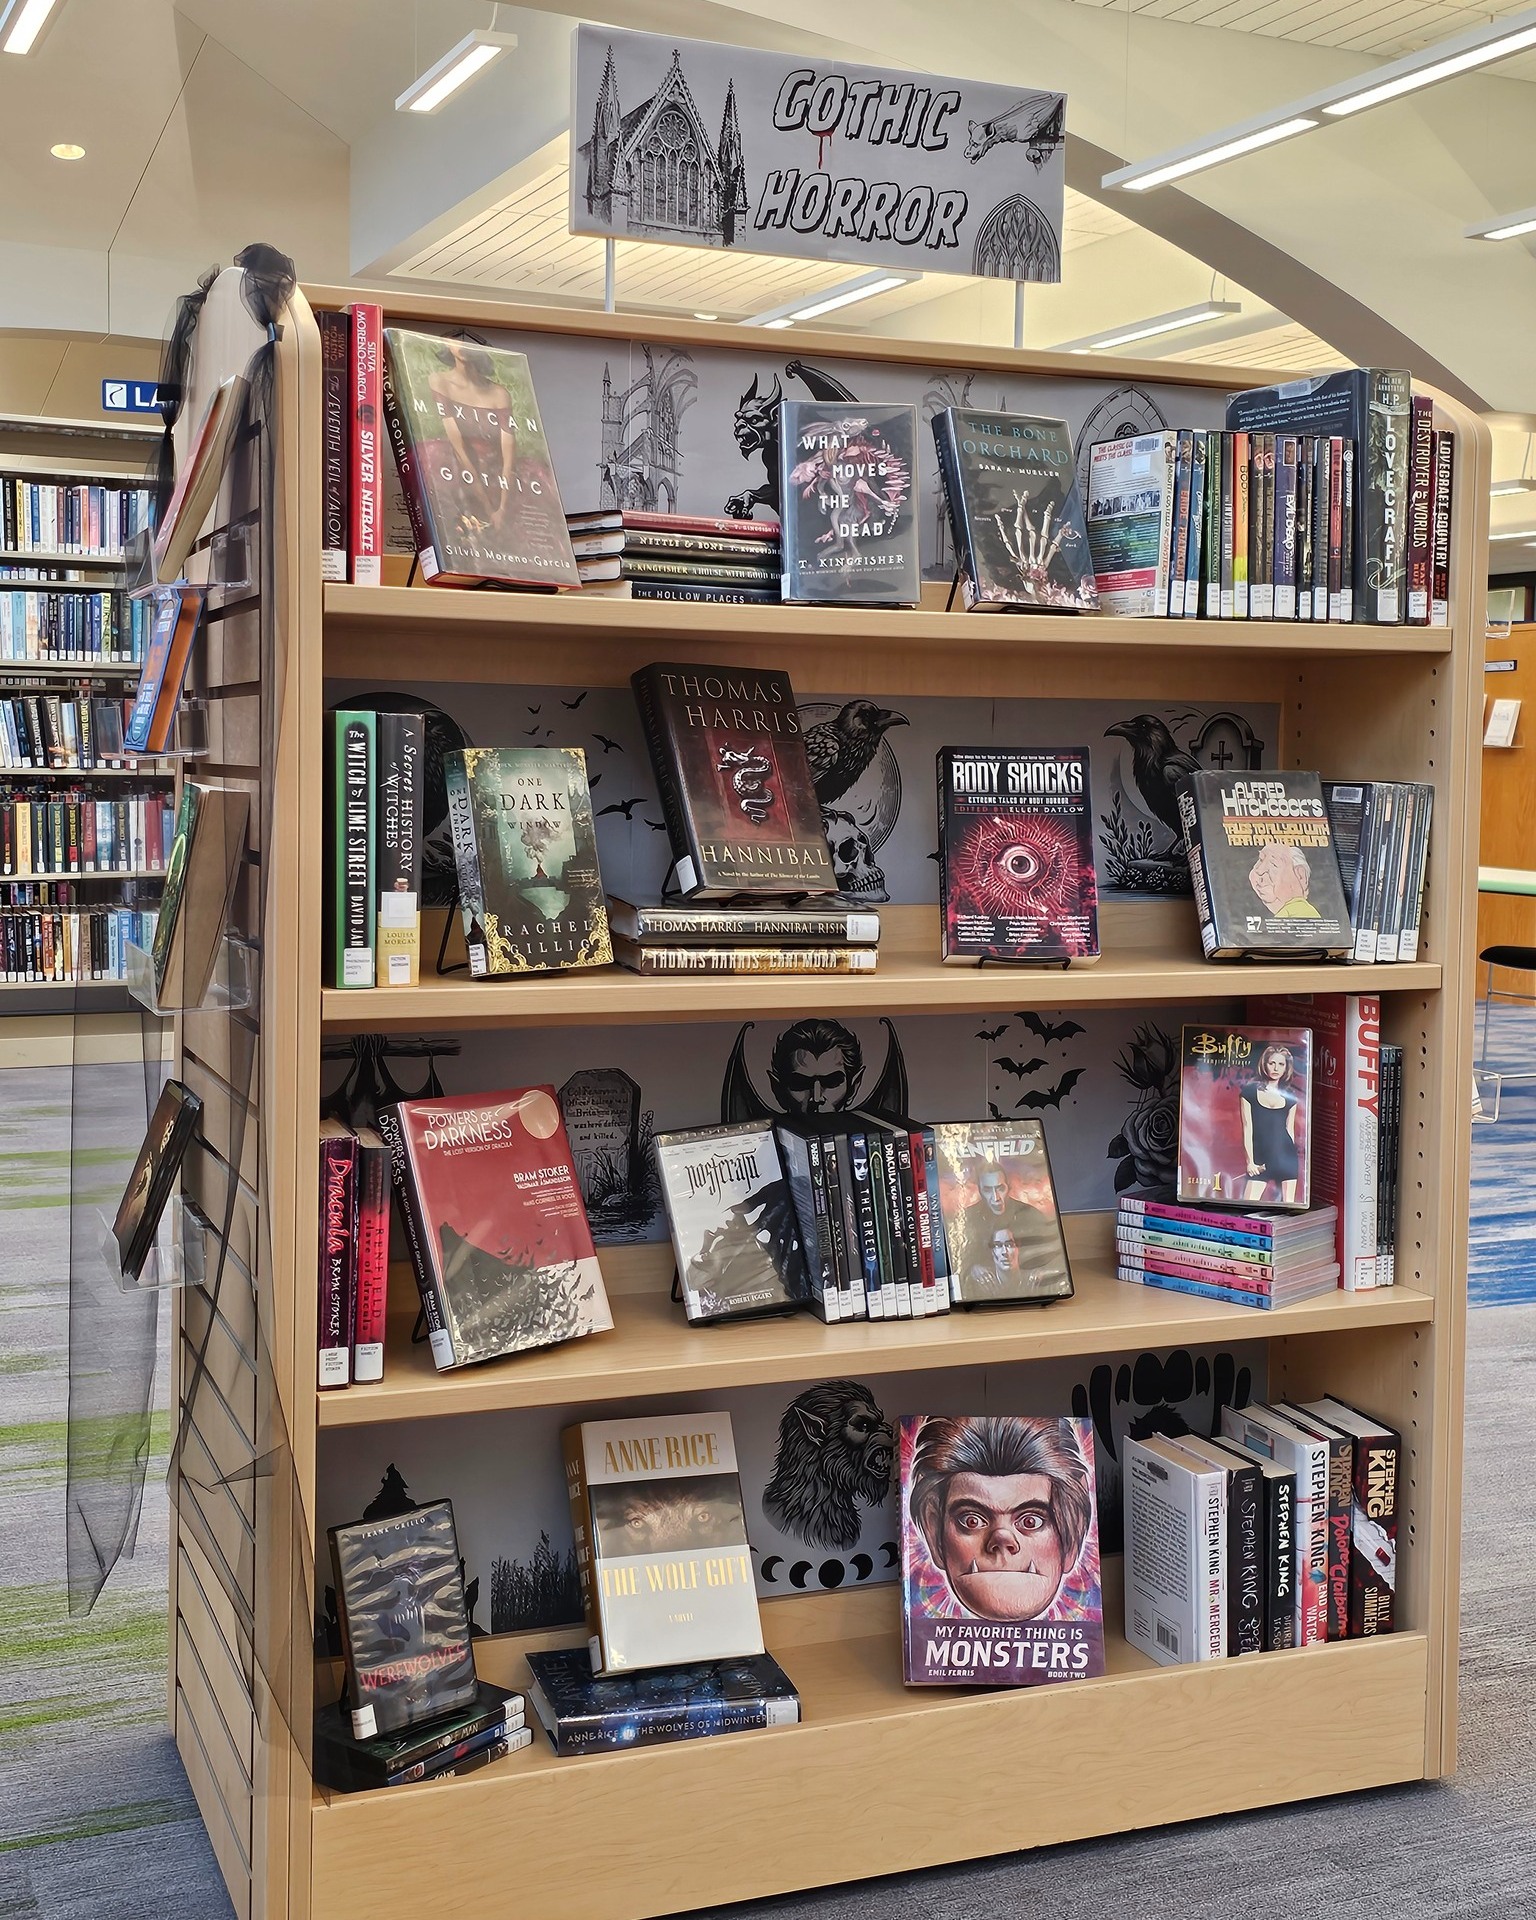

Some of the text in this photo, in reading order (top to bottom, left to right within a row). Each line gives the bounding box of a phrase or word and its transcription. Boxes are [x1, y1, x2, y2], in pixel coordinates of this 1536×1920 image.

[772, 68, 961, 152] GOTHIC
[754, 168, 968, 249] HORROR
[356, 311, 368, 402] MORENO-GARCIA
[367, 341, 377, 373] SILVIA
[1382, 393, 1400, 406] H.P.
[1417, 409, 1432, 418] THE
[382, 357, 410, 474] XICAN GOTHIC
[413, 400, 538, 433] MEXICAN
[328, 391, 341, 483] SEVENTH VEIL
[802, 434, 850, 450] WHAT
[967, 421, 1058, 442] THE BONE
[962, 439, 1070, 466] ORCHARD
[440, 466, 543, 496] GOTHIC
[832, 461, 887, 478] MOVES
[978, 463, 1060, 478] SARA MUELLER
[1412, 419, 1431, 549] DESTROYER OF WORLDS
[360, 430, 375, 552] SILVER NITRATE
[820, 494, 850, 510] THE
[1384, 415, 1398, 578] LOVECRAFT
[1435, 440, 1451, 568] LOVECRAFT COUNTRY
[639, 536, 724, 551] NETTLE BONE
[840, 522, 885, 538] DEAD
[445, 545, 572, 570] Silvia Moreno-Garcia
[637, 563, 689, 575] KINGFISHER
[819, 553, 905, 568] KINGFISHER
[638, 590, 745, 604] THE HOLLOW PLACES
[660, 673, 784, 703] THOMAS
[349, 730, 365, 739] The
[684, 705, 800, 734] HARRIS
[517, 777, 543, 787] ONE
[952, 761, 1083, 794] BODY SHOCKS
[1234, 781, 1286, 799] ALFRED
[347, 742, 367, 887] WITCH of LIME STREET
[384, 772, 402, 849] WITCHES
[401, 744, 417, 873] Secret HISTORY
[500, 792, 566, 811] DARK
[968, 796, 997, 804] EXTREME
[700, 844, 829, 866] HANNIBAL
[350, 895, 364, 925] DAVID
[1246, 916, 1262, 931] 27
[503, 919, 593, 937] RACHEL
[647, 919, 848, 934] THOMAS HARRIS HANNIBAL RISIN
[509, 938, 591, 955] GILLIG
[650, 951, 760, 970] THOMAS HARRIS
[1191, 1033, 1252, 1065] Buffy
[1357, 996, 1380, 1118] BUFFY
[428, 1110, 493, 1129] POWERS OF
[389, 1117, 405, 1158] POWERS
[424, 1120, 513, 1150] DARKNESS
[883, 1143, 897, 1185] DRACULA
[1363, 1115, 1372, 1186] VAMPIRE SLAYER
[513, 1165, 570, 1183] BRAM STOKER
[1188, 1171, 1222, 1191] SEASON 1
[327, 1157, 353, 1255] Dracula
[930, 1193, 938, 1212] VAN
[860, 1188, 877, 1262] THE BREED
[905, 1195, 916, 1243] DRACULA
[917, 1190, 932, 1249] WES CRAVEN
[1360, 1211, 1368, 1249] VAUGHAN
[364, 1261, 373, 1274] of
[372, 1228, 385, 1319] RENFIELD
[329, 1258, 342, 1337] BRAM STOKER
[427, 1289, 436, 1313] BRAM
[603, 1432, 720, 1474] ANNE RICE
[1329, 1456, 1340, 1498] KING
[1367, 1449, 1386, 1518] KING
[1384, 1449, 1396, 1516] STEPHEN
[394, 1516, 426, 1531] GRILLO
[1310, 1450, 1326, 1569] STEPHEN KING
[1240, 1498, 1257, 1561] STEPHEN
[1277, 1484, 1290, 1598] STEPHEN KING
[1329, 1513, 1350, 1566] Dolores
[602, 1555, 750, 1599] THE WOLF GIFT
[1208, 1497, 1221, 1659] STEPHEN KING MERCEDE
[1241, 1564, 1259, 1610] KING
[1318, 1583, 1328, 1623] END OF
[1363, 1586, 1379, 1635] SUMMERS
[1378, 1594, 1391, 1622] BILLY
[935, 1625, 1083, 1640] MY FAVORITE THING IS
[1305, 1606, 1318, 1645] WATCH
[360, 1643, 470, 1693] WEREWOLVES
[925, 1640, 1089, 1669] MONSTERS
[928, 1669, 975, 1677] EMIL FERRIS
[1047, 1671, 1086, 1679] BOOK TWO
[567, 1714, 767, 1743] ANNE WOLVES OF MIDWINTER
